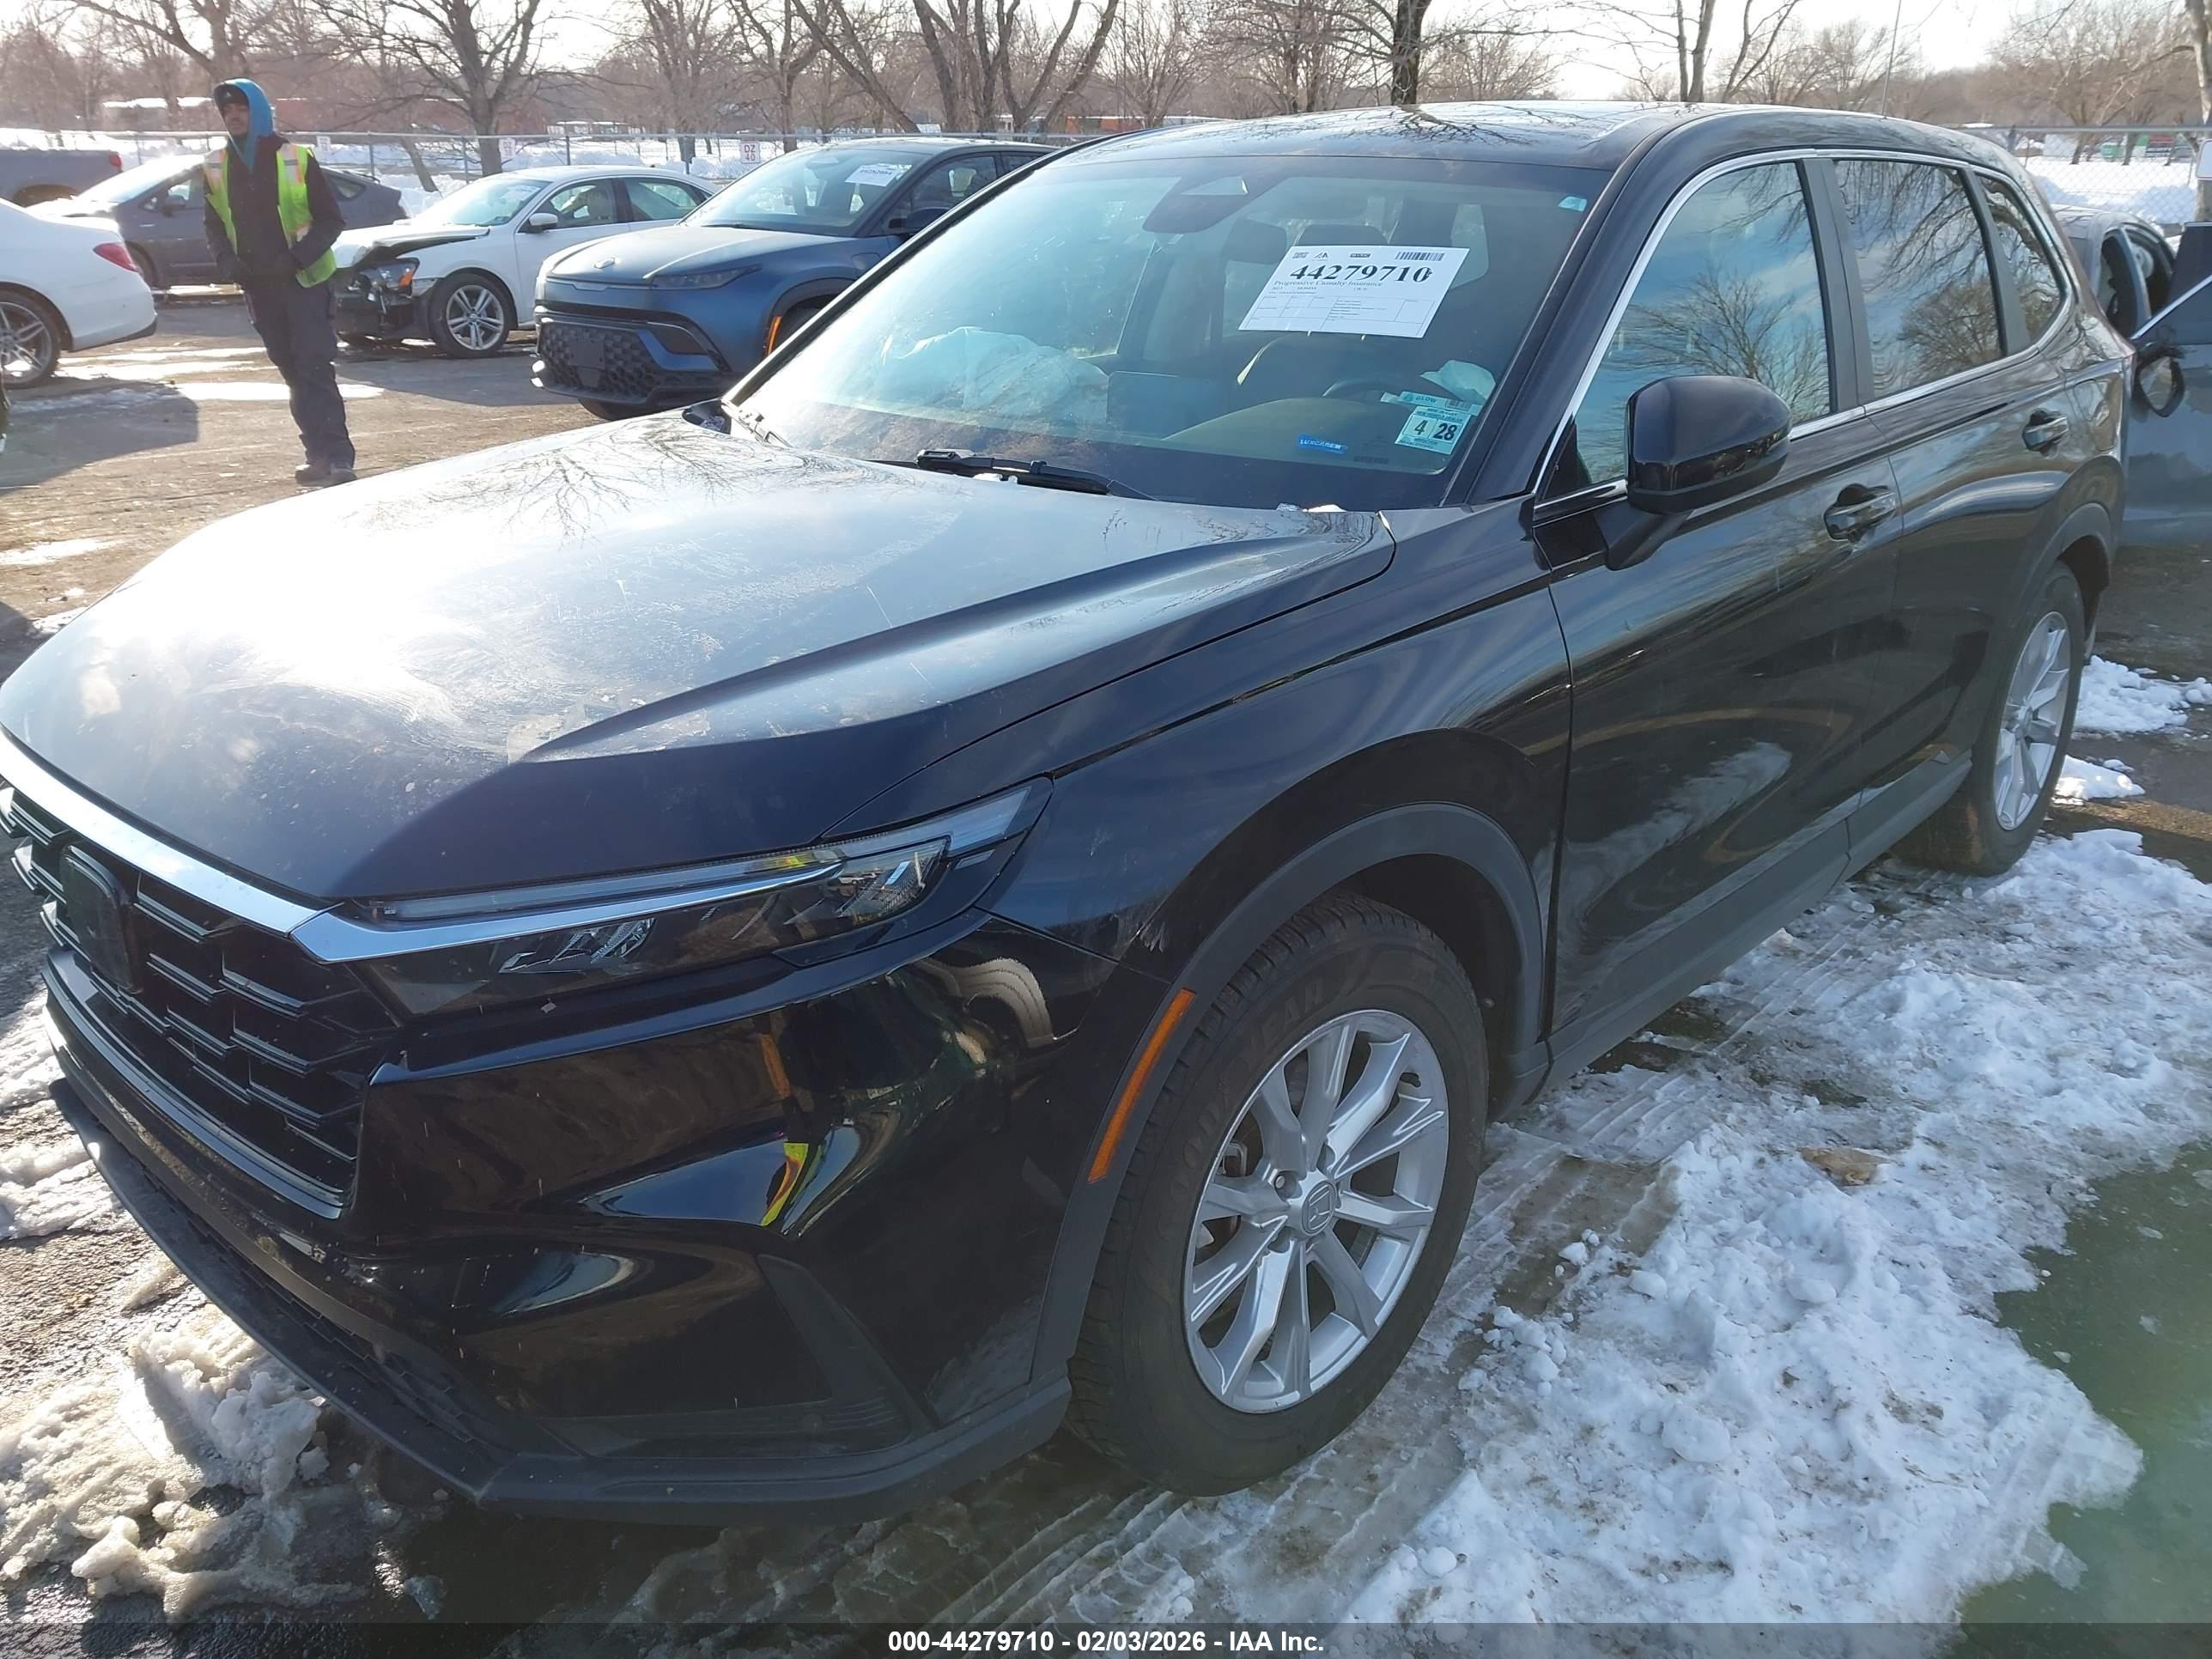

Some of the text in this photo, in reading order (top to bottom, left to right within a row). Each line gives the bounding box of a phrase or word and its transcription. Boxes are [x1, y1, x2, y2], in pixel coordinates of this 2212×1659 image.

[744, 144, 756, 153] DZ
[1290, 264, 1432, 283] 44279710
[1414, 420, 1457, 441] 4 28
